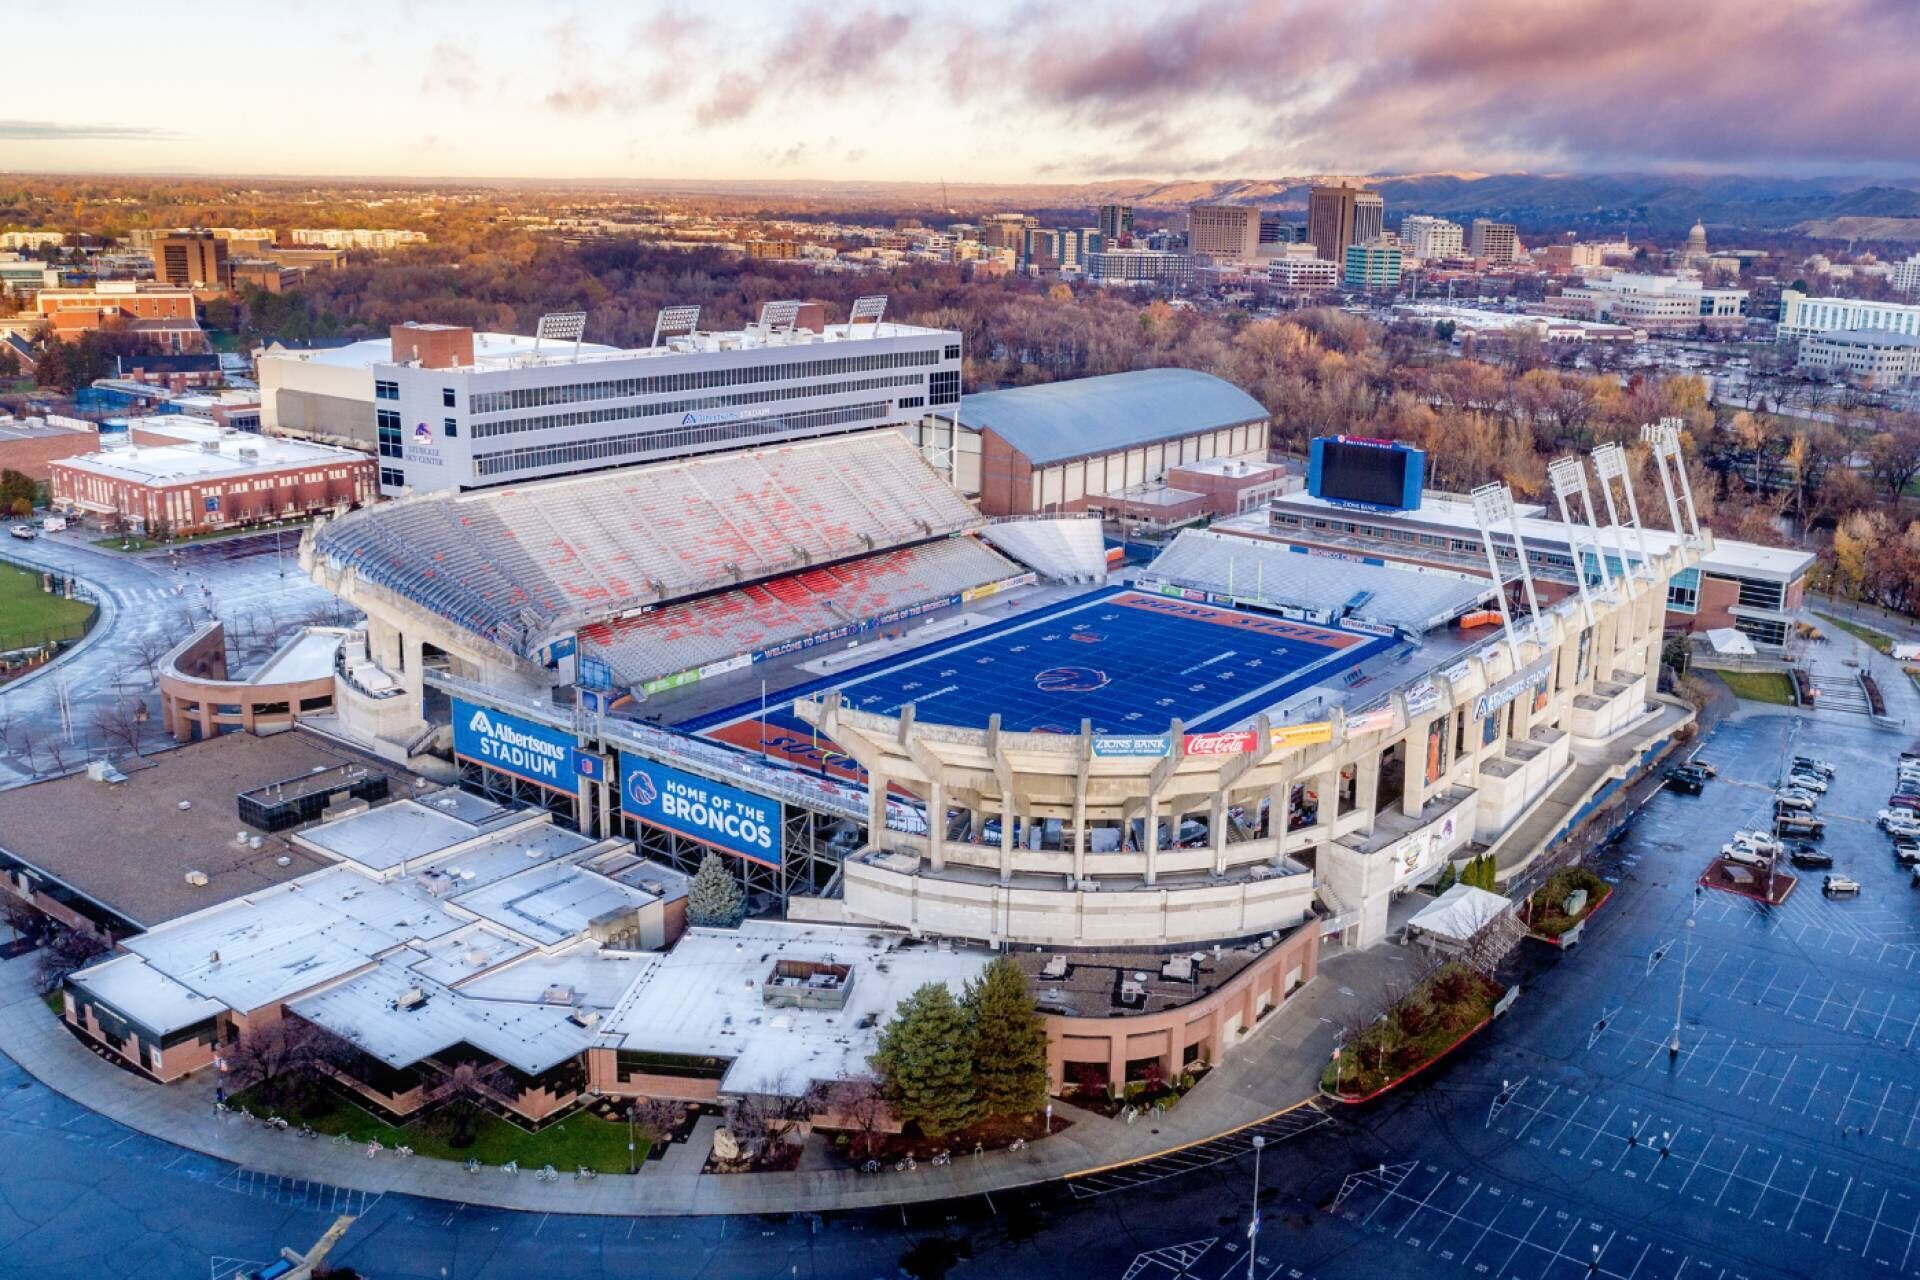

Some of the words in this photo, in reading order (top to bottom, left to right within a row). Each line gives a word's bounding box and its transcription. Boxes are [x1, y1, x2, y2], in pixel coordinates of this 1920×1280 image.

[764, 640, 802, 659] WELCOME
[803, 637, 813, 648] TO
[815, 632, 829, 643] THE
[830, 626, 848, 640] BLUE
[480, 738, 557, 778] STADIUM
[494, 722, 564, 760] Albertsons
[1095, 739, 1131, 749] ZIONS
[1134, 739, 1166, 749] BANK
[666, 780, 707, 804] HOME
[712, 795, 731, 810] OF
[735, 802, 765, 821] THE
[661, 792, 771, 849] BRONCOS
